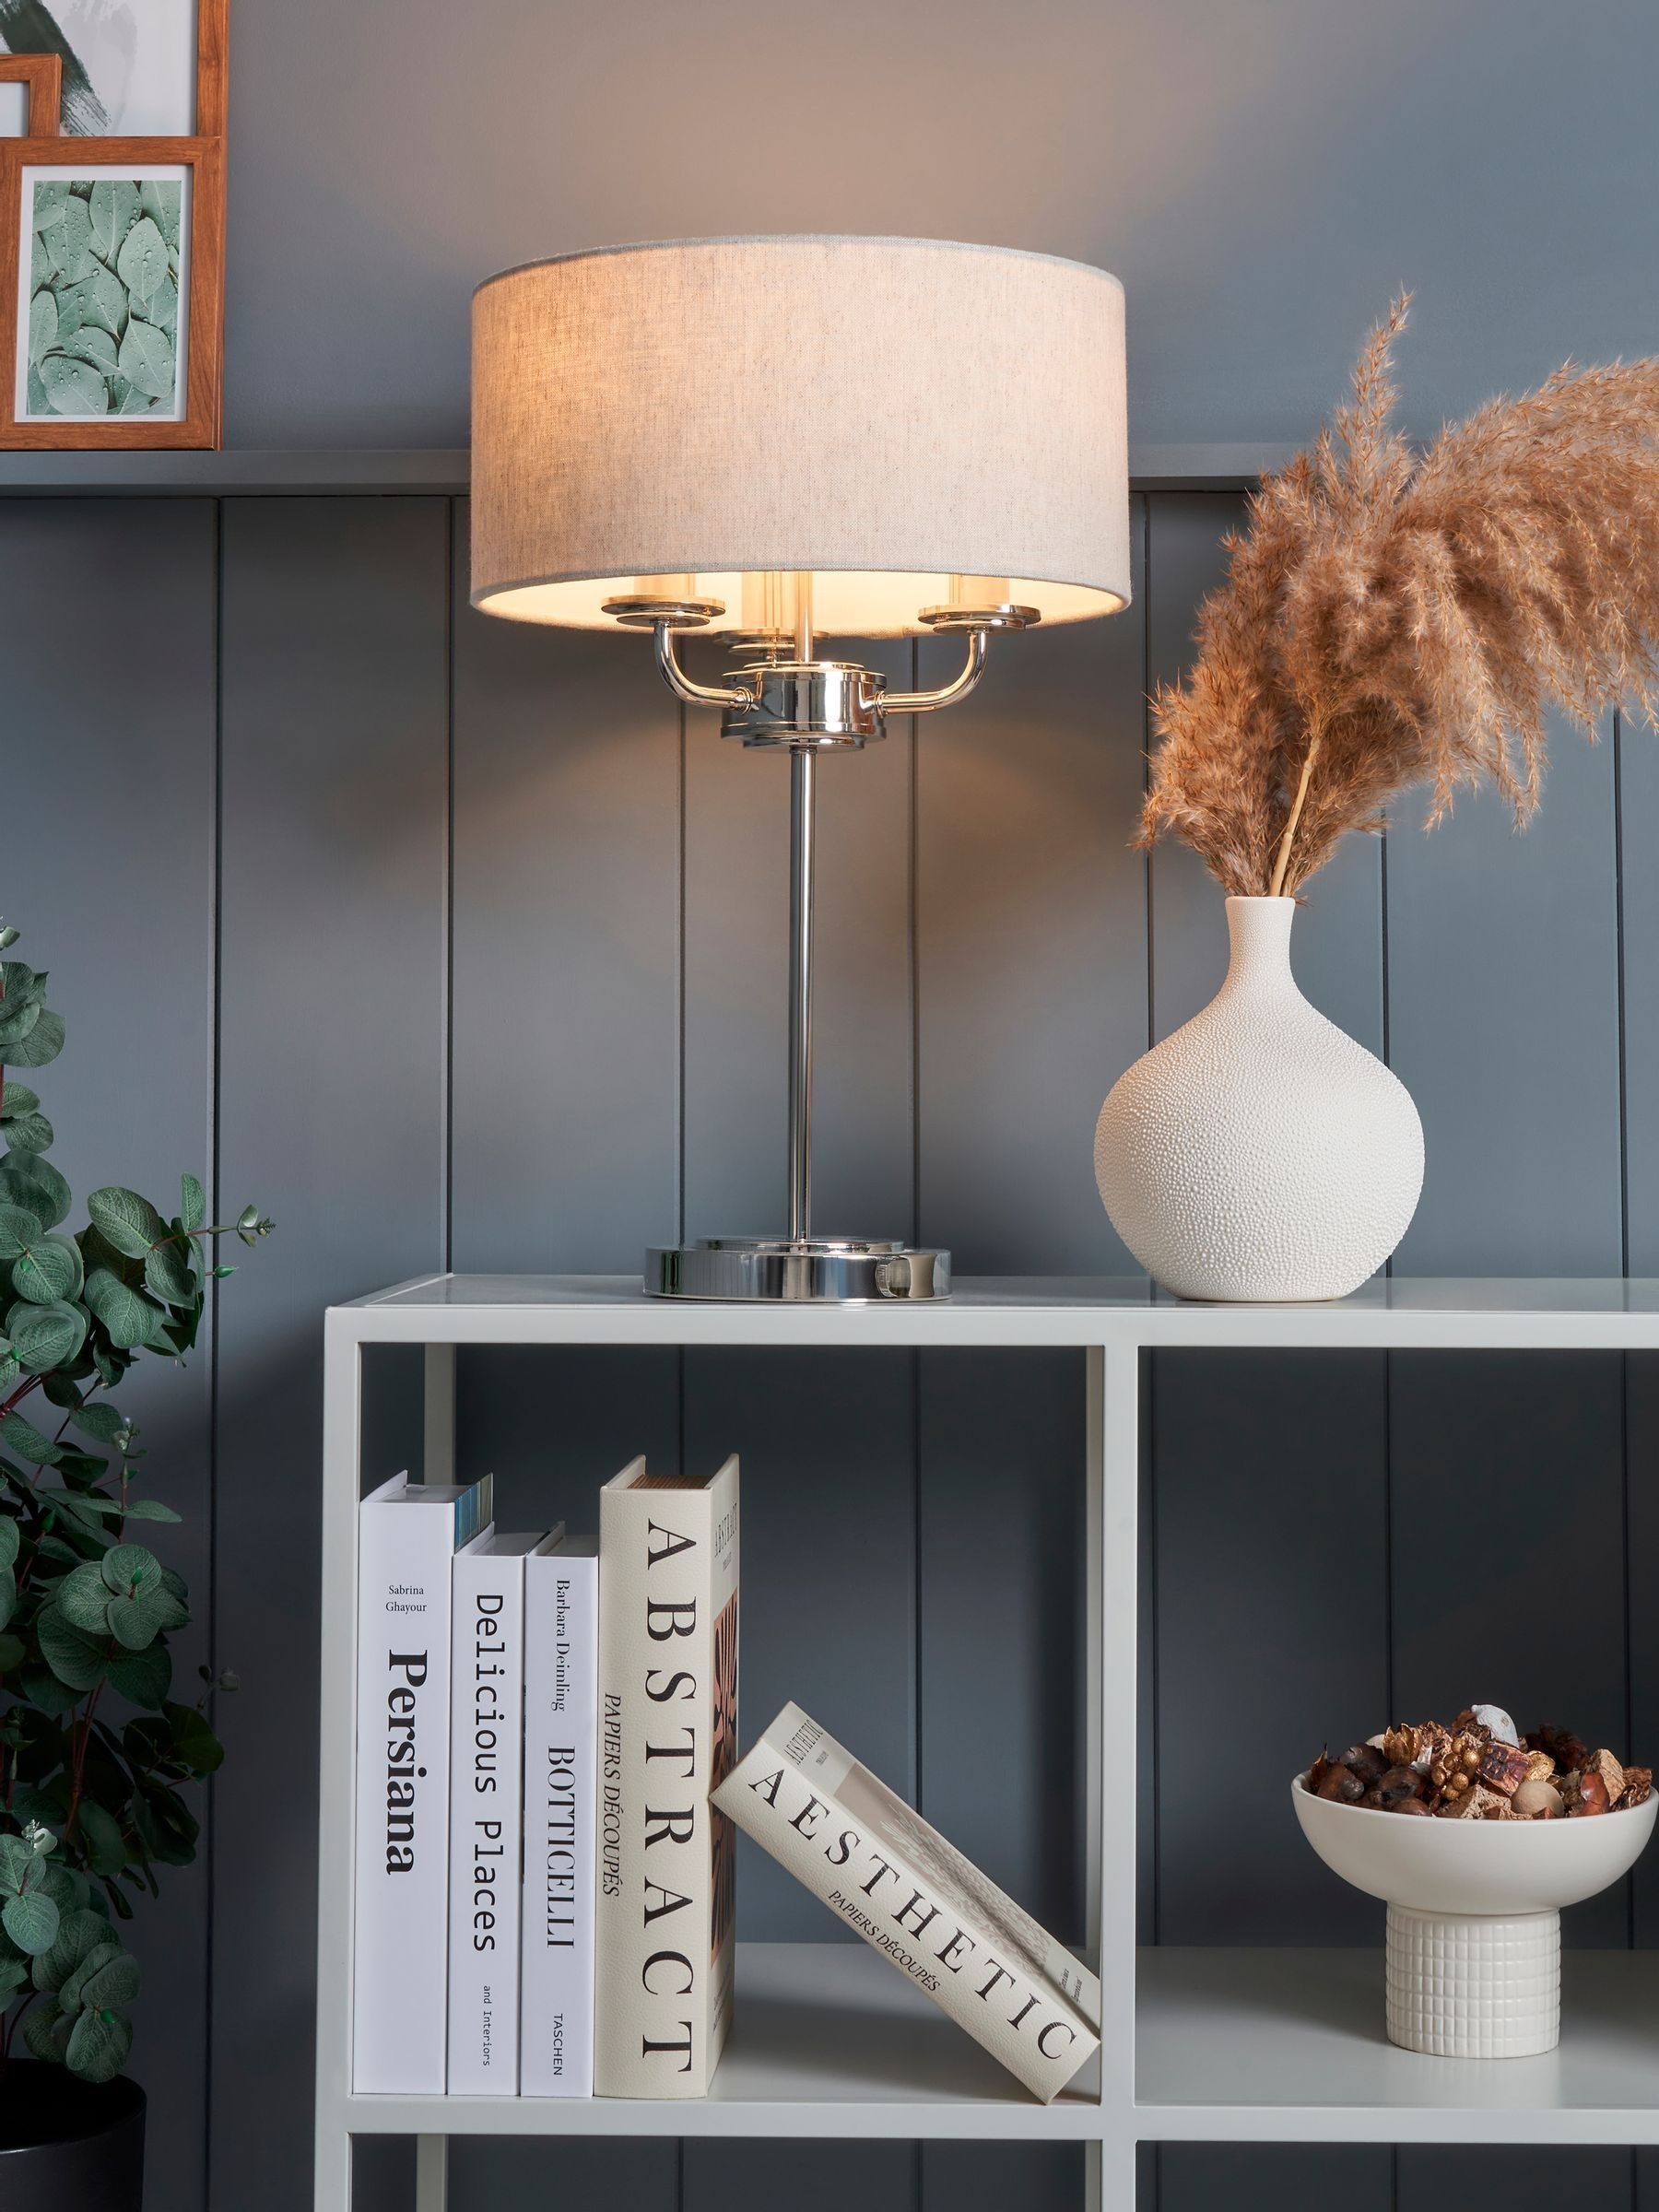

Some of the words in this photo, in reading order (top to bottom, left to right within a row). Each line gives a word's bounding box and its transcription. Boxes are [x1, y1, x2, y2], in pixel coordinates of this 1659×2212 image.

[385, 1601, 428, 1615] Ghayour
[388, 1584, 424, 1595] Sabrina
[556, 1579, 571, 1638] Barbara
[474, 1594, 506, 1794] Delicious
[550, 1642, 571, 1712] Deimling
[385, 1648, 429, 1876] Persiana
[603, 1692, 622, 1781] PAPIERS
[783, 1719, 823, 1766] AESTHETIC
[641, 1516, 698, 2073] ABSTRACT
[547, 1745, 576, 1949] BOTTICELLI
[602, 1783, 624, 1898] DÉCOUPÉS
[473, 1819, 503, 1952] Places
[748, 1768, 1077, 2060] AESTHETIC
[828, 1890, 879, 1937] PAPIERS
[876, 1933, 941, 1993] DÉCOUPÉS
[482, 1985, 492, 2006] and
[482, 2010, 492, 2066] Interiors
[553, 2012, 563, 2076] TASCHEN
